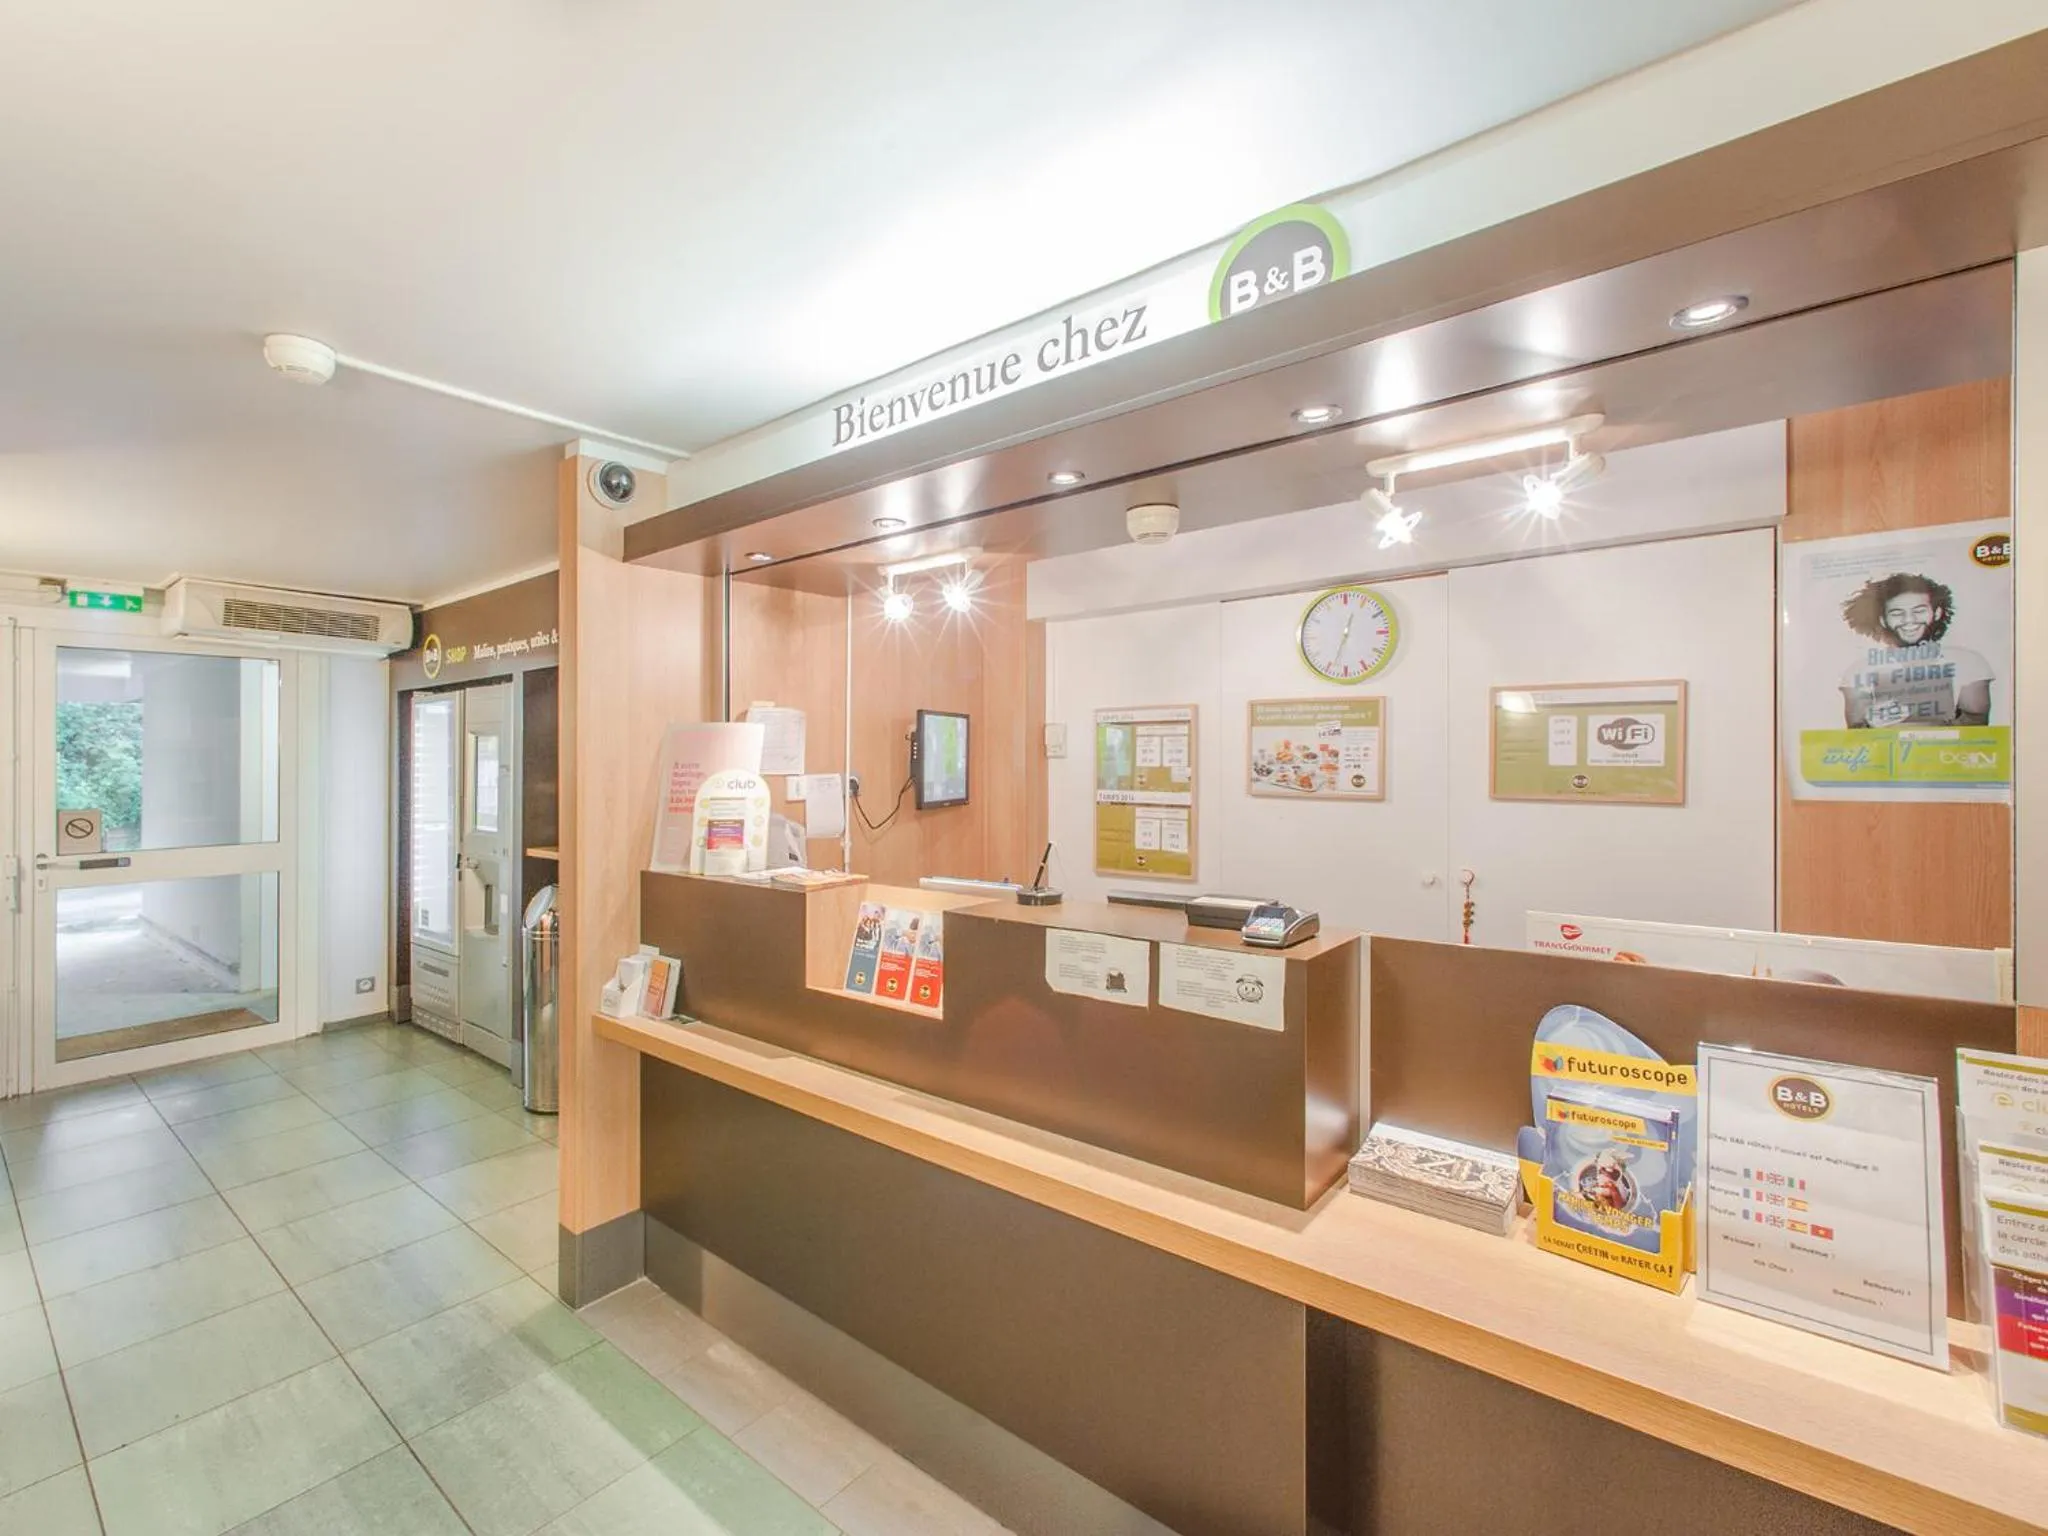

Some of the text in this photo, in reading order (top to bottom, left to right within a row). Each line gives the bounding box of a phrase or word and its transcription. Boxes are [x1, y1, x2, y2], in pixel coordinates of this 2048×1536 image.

[832, 304, 1147, 447] Bienvenue chez
[1890, 662, 1956, 684] FIBRE
[1567, 1056, 1688, 1087] futuroscope
[1776, 1085, 1828, 1109] B&B
[1783, 1101, 1821, 1114] HOTELS
[1571, 1110, 1637, 1130] futuroscope
[1997, 1215, 2035, 1231] Entrez
